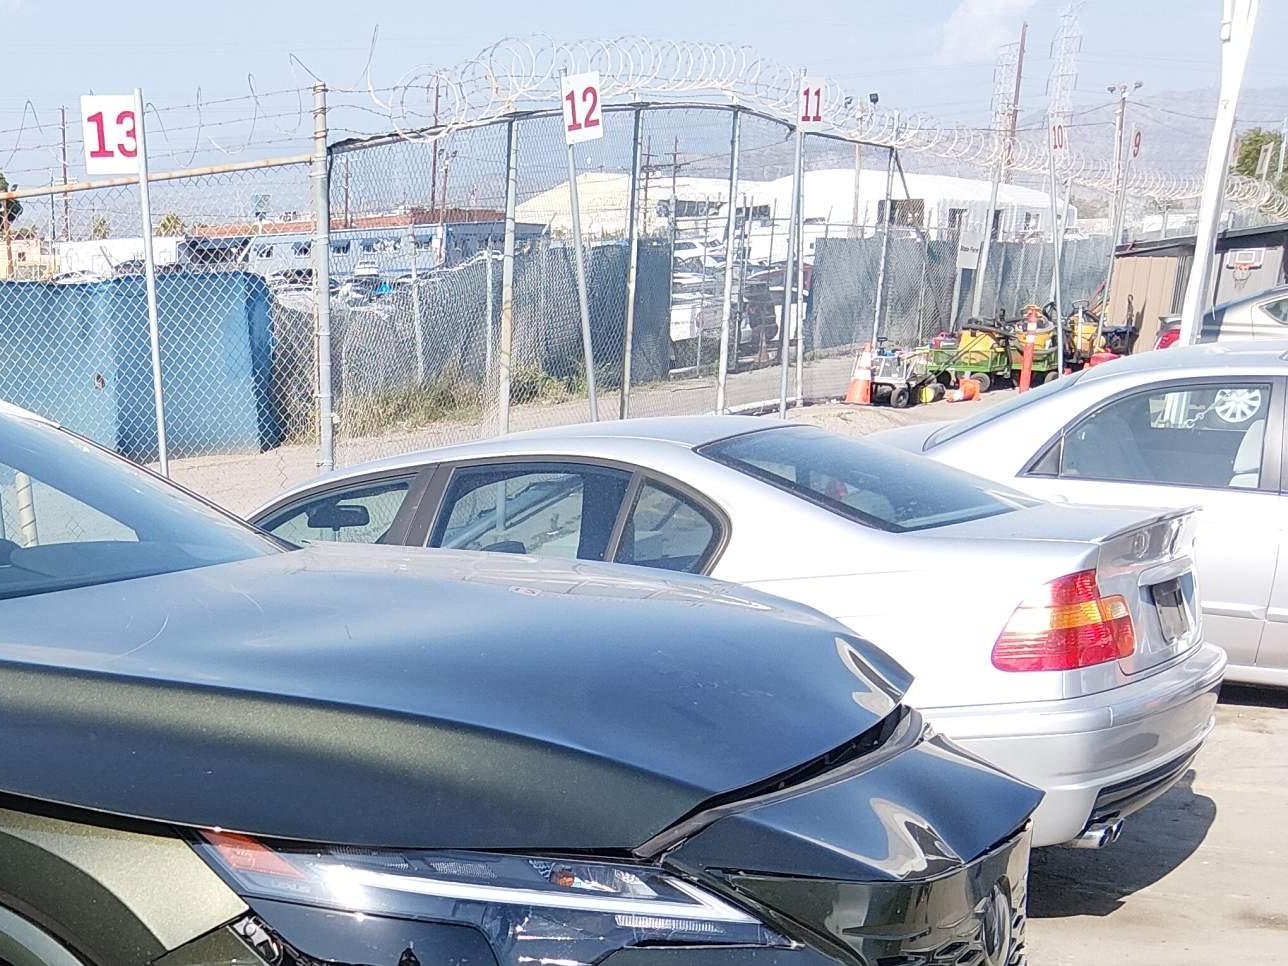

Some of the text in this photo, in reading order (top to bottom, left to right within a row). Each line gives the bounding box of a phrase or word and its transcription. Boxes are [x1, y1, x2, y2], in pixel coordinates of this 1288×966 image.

[565, 86, 600, 132] 12
[801, 87, 822, 122] 11
[87, 110, 138, 158] 13
[1052, 124, 1064, 150] 10
[1133, 131, 1142, 158] 9
